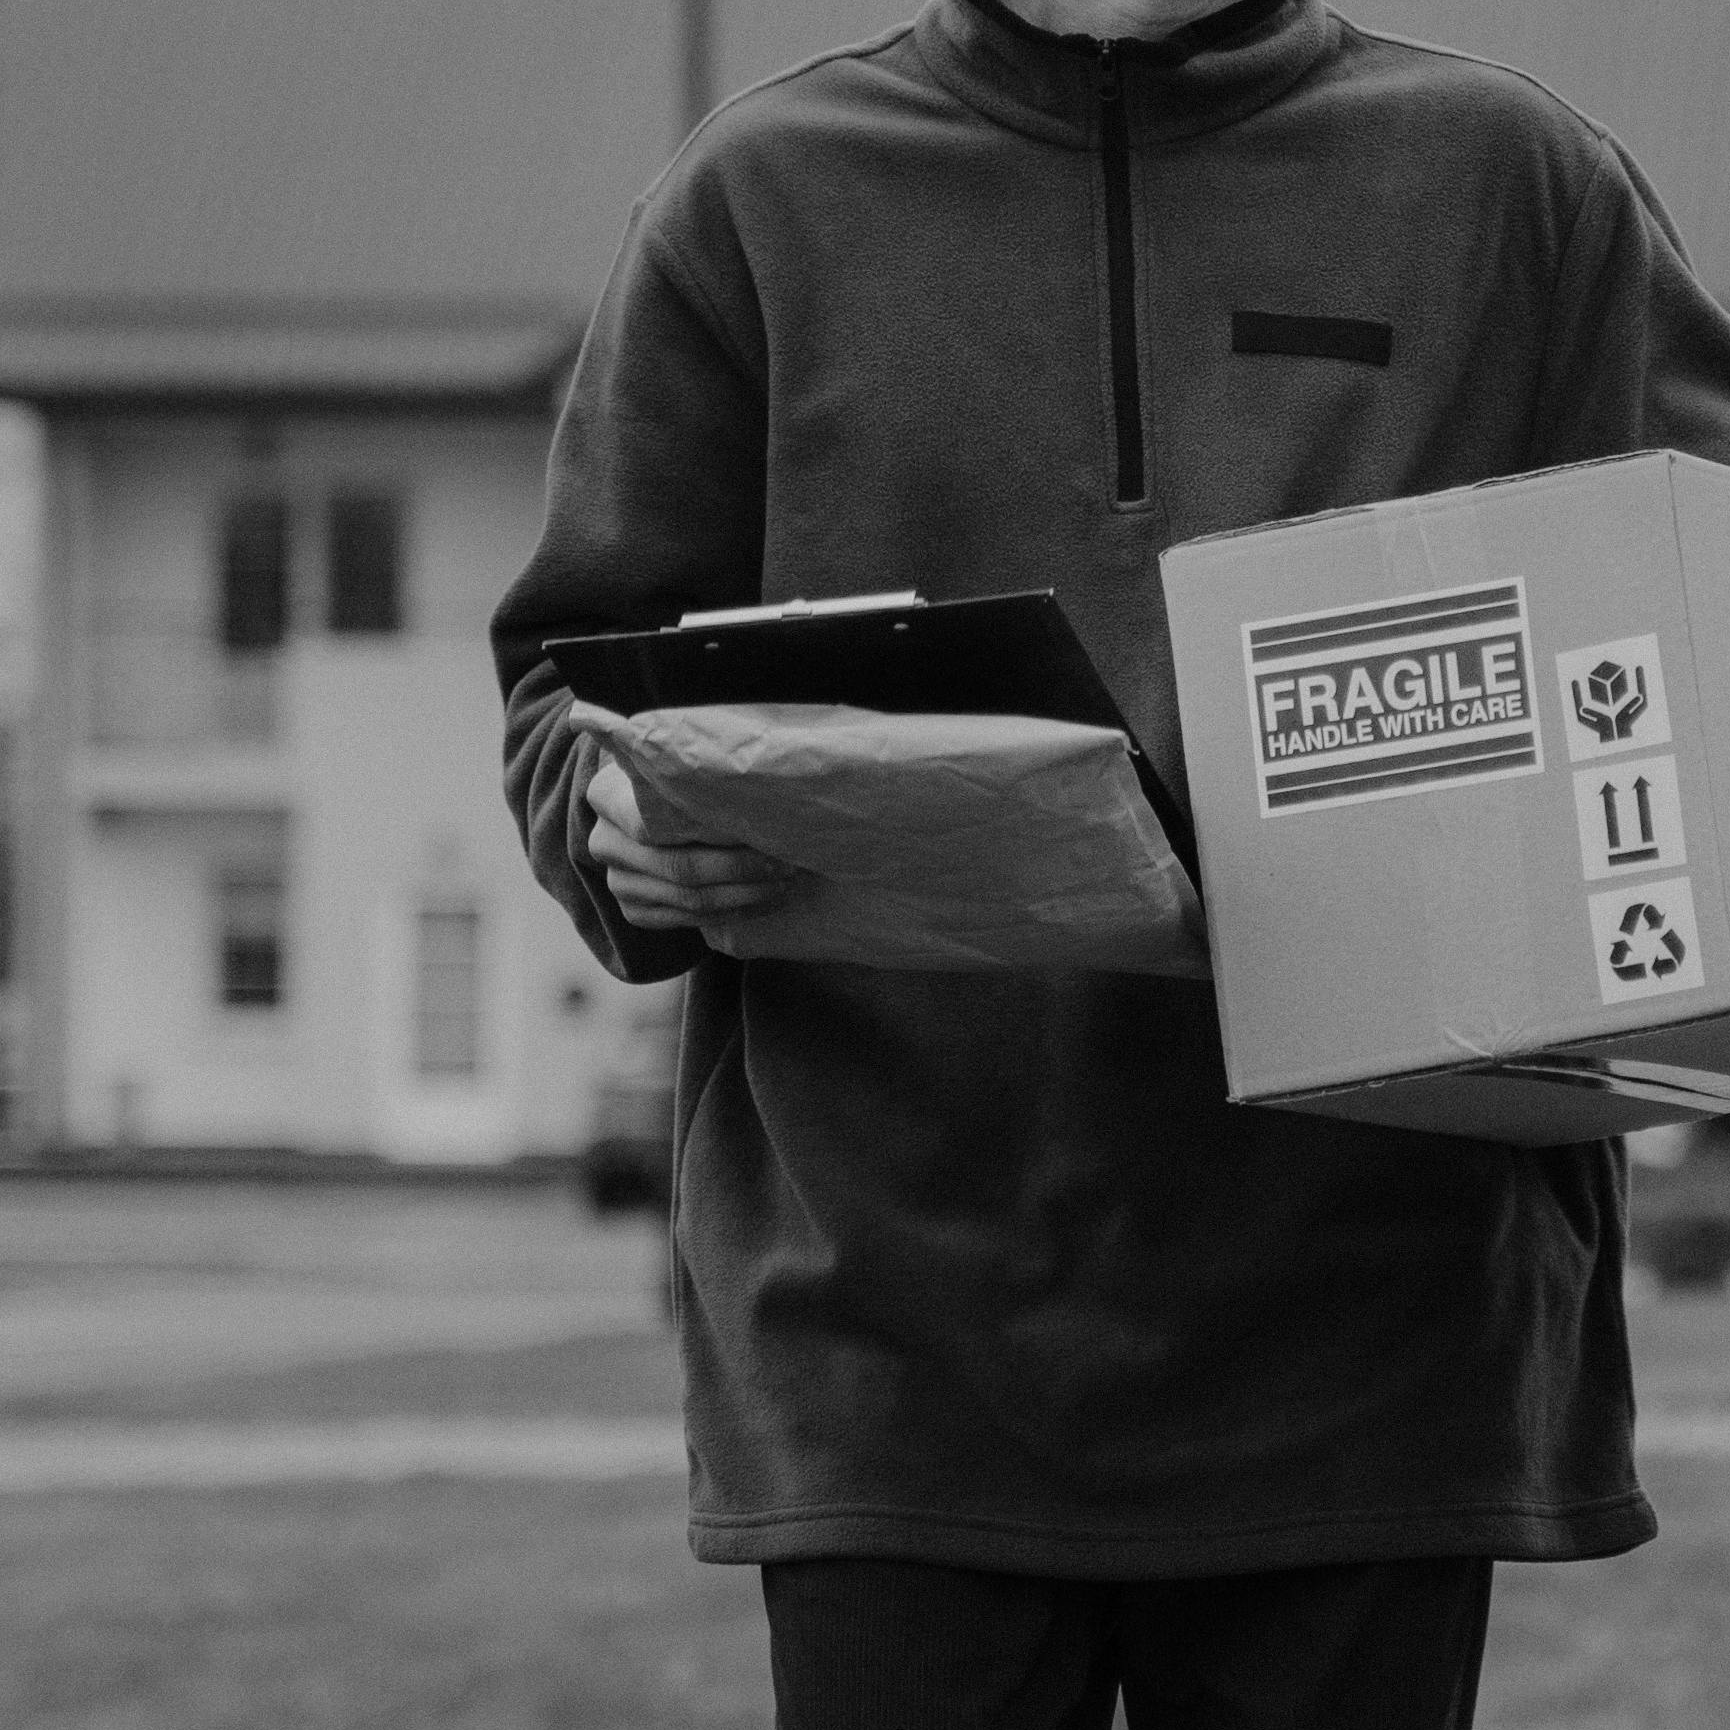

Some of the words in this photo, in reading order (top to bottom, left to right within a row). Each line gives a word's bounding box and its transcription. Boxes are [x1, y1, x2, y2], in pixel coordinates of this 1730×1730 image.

[1262, 641, 1521, 732] FRAGILE
[1268, 719, 1374, 758] HANDLE
[1379, 710, 1445, 738] WITH
[1451, 694, 1523, 727] CARE
